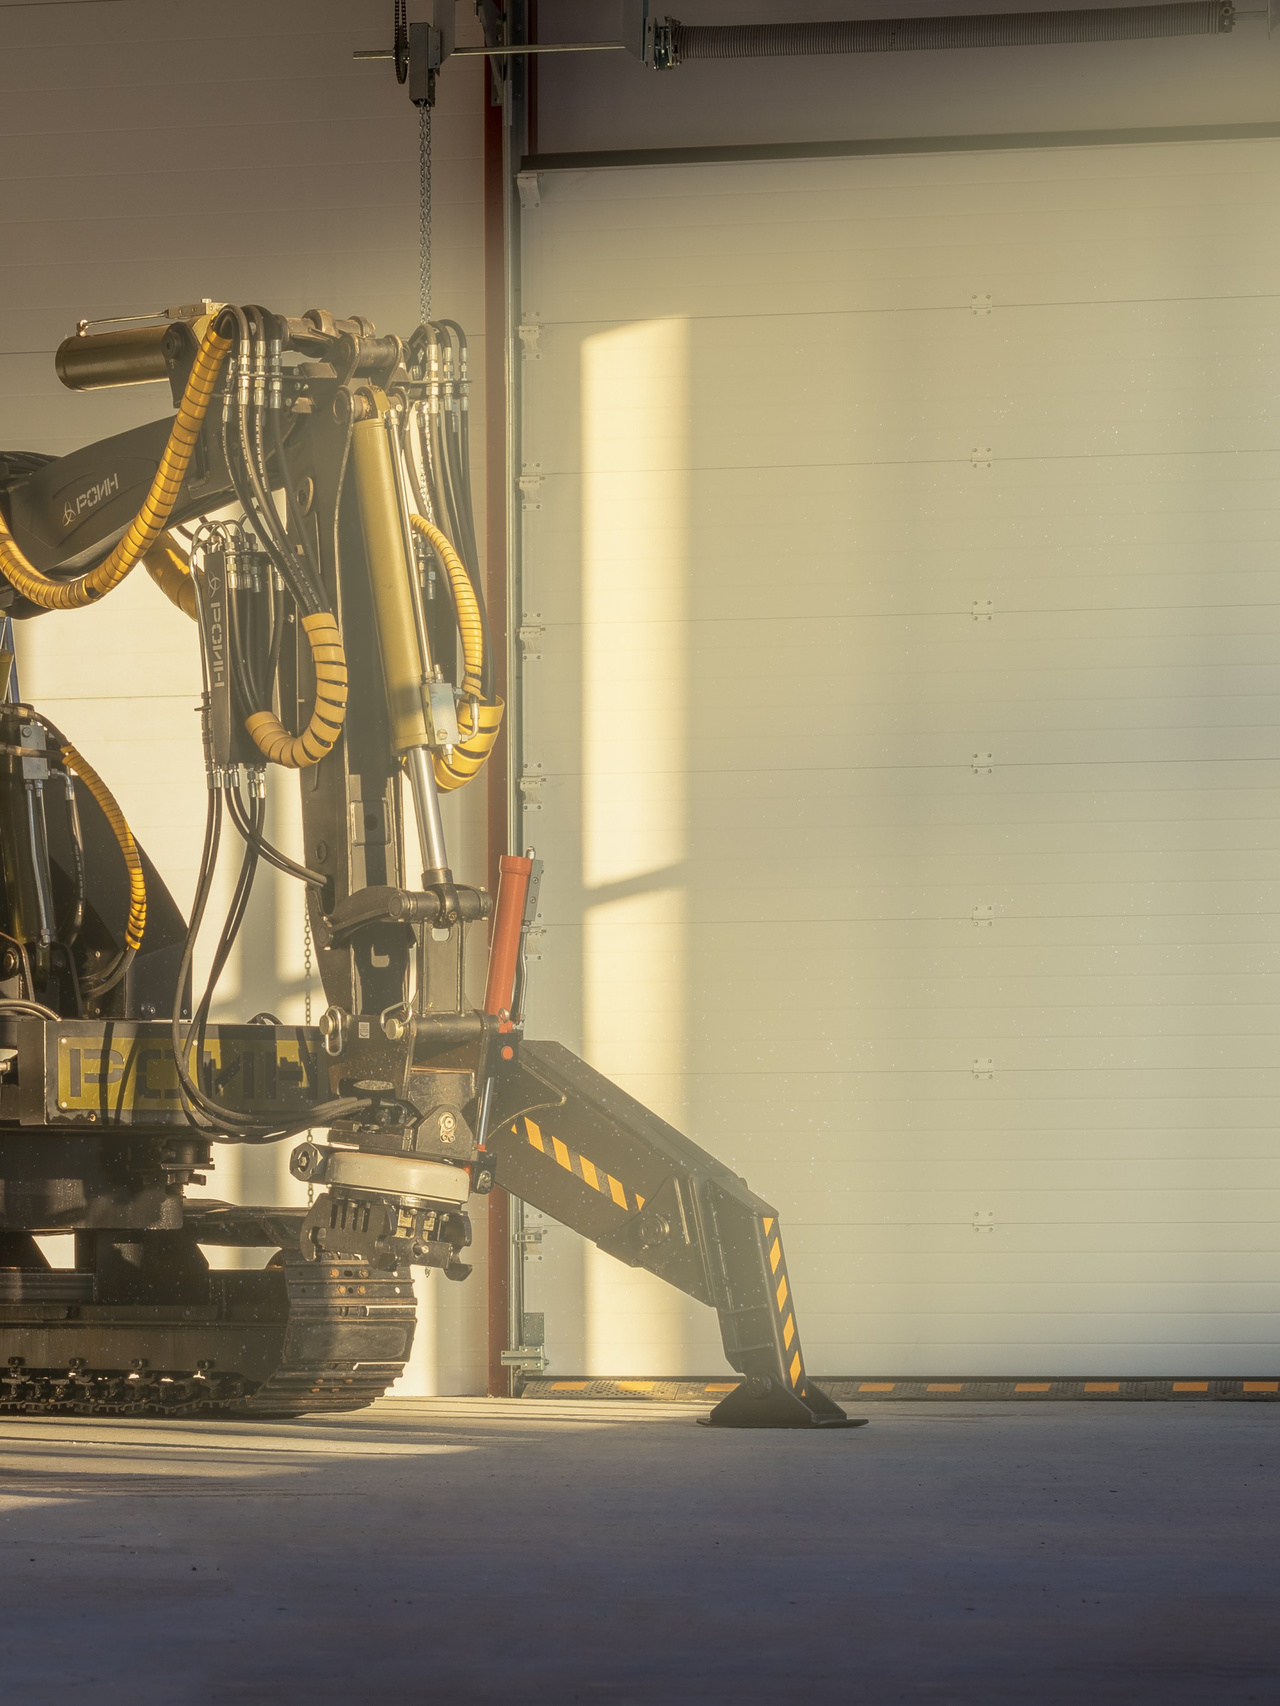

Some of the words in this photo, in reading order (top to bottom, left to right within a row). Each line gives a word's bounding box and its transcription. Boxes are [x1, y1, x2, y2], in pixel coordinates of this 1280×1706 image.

[76, 472, 119, 515] РОИН
[210, 602, 225, 688] РОИН
[69, 1048, 319, 1100] РОИН
